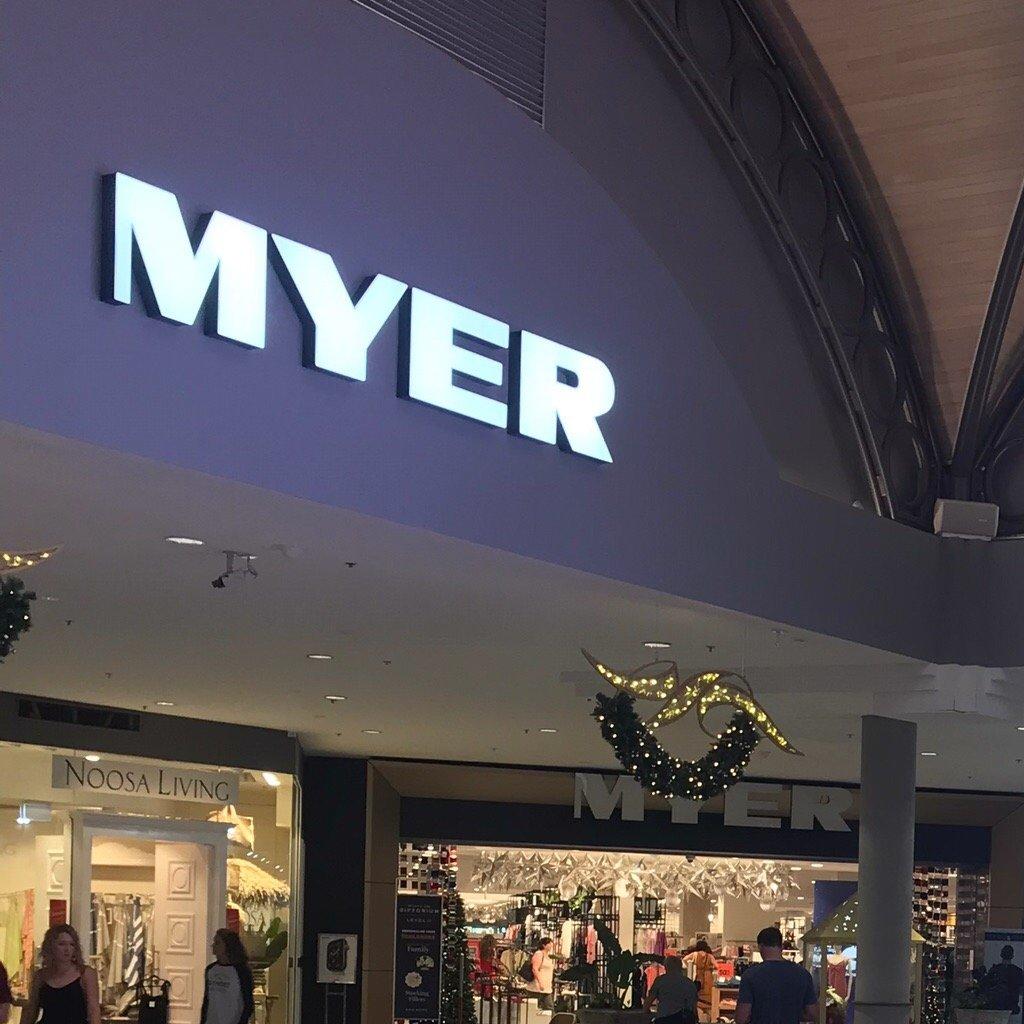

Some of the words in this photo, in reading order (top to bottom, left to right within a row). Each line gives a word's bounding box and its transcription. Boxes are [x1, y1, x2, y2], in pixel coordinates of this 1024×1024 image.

[102, 172, 616, 464] MYER
[66, 759, 150, 794] NOOSA
[158, 769, 229, 801] LIVING
